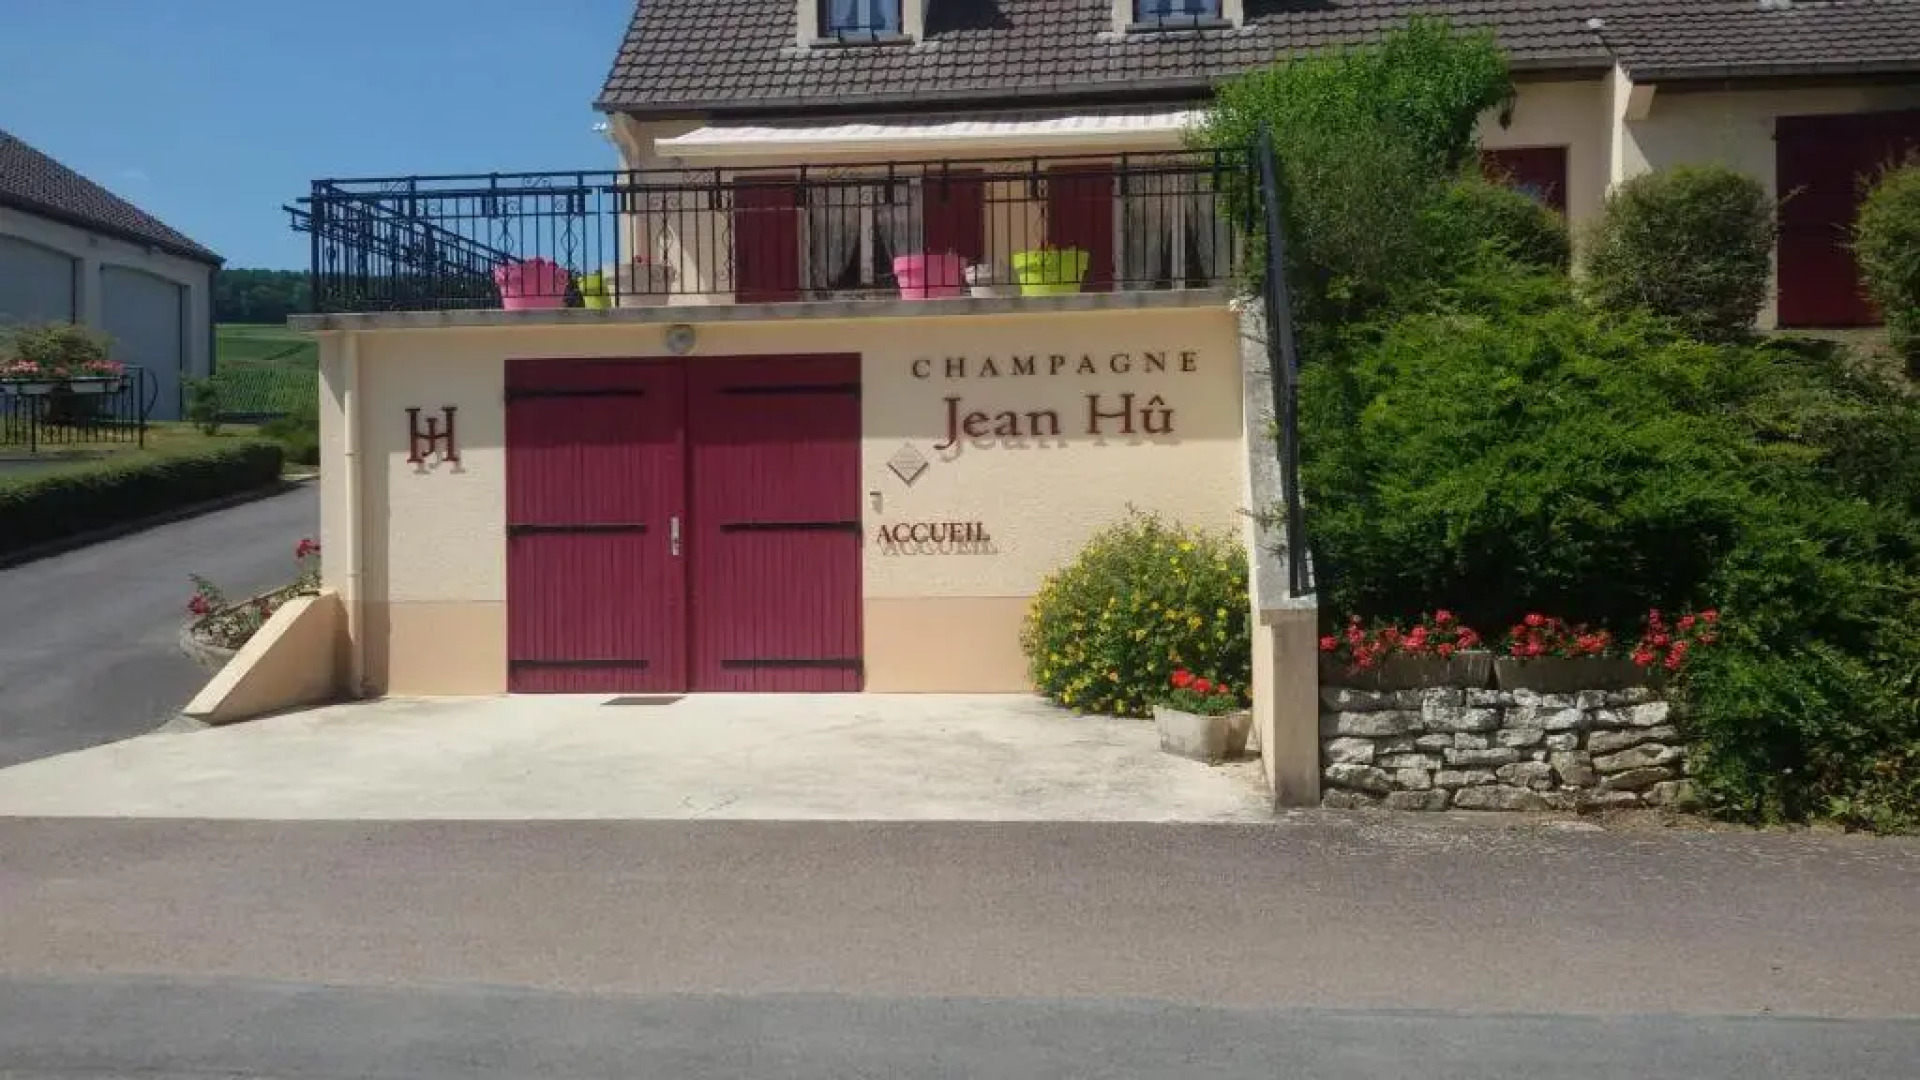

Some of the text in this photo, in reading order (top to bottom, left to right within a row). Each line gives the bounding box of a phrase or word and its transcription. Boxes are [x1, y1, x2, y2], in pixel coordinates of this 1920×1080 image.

[911, 351, 1198, 378] CHAMPAGNE
[933, 393, 1174, 450] Jean Hû
[877, 522, 990, 543] ACCUEIL
